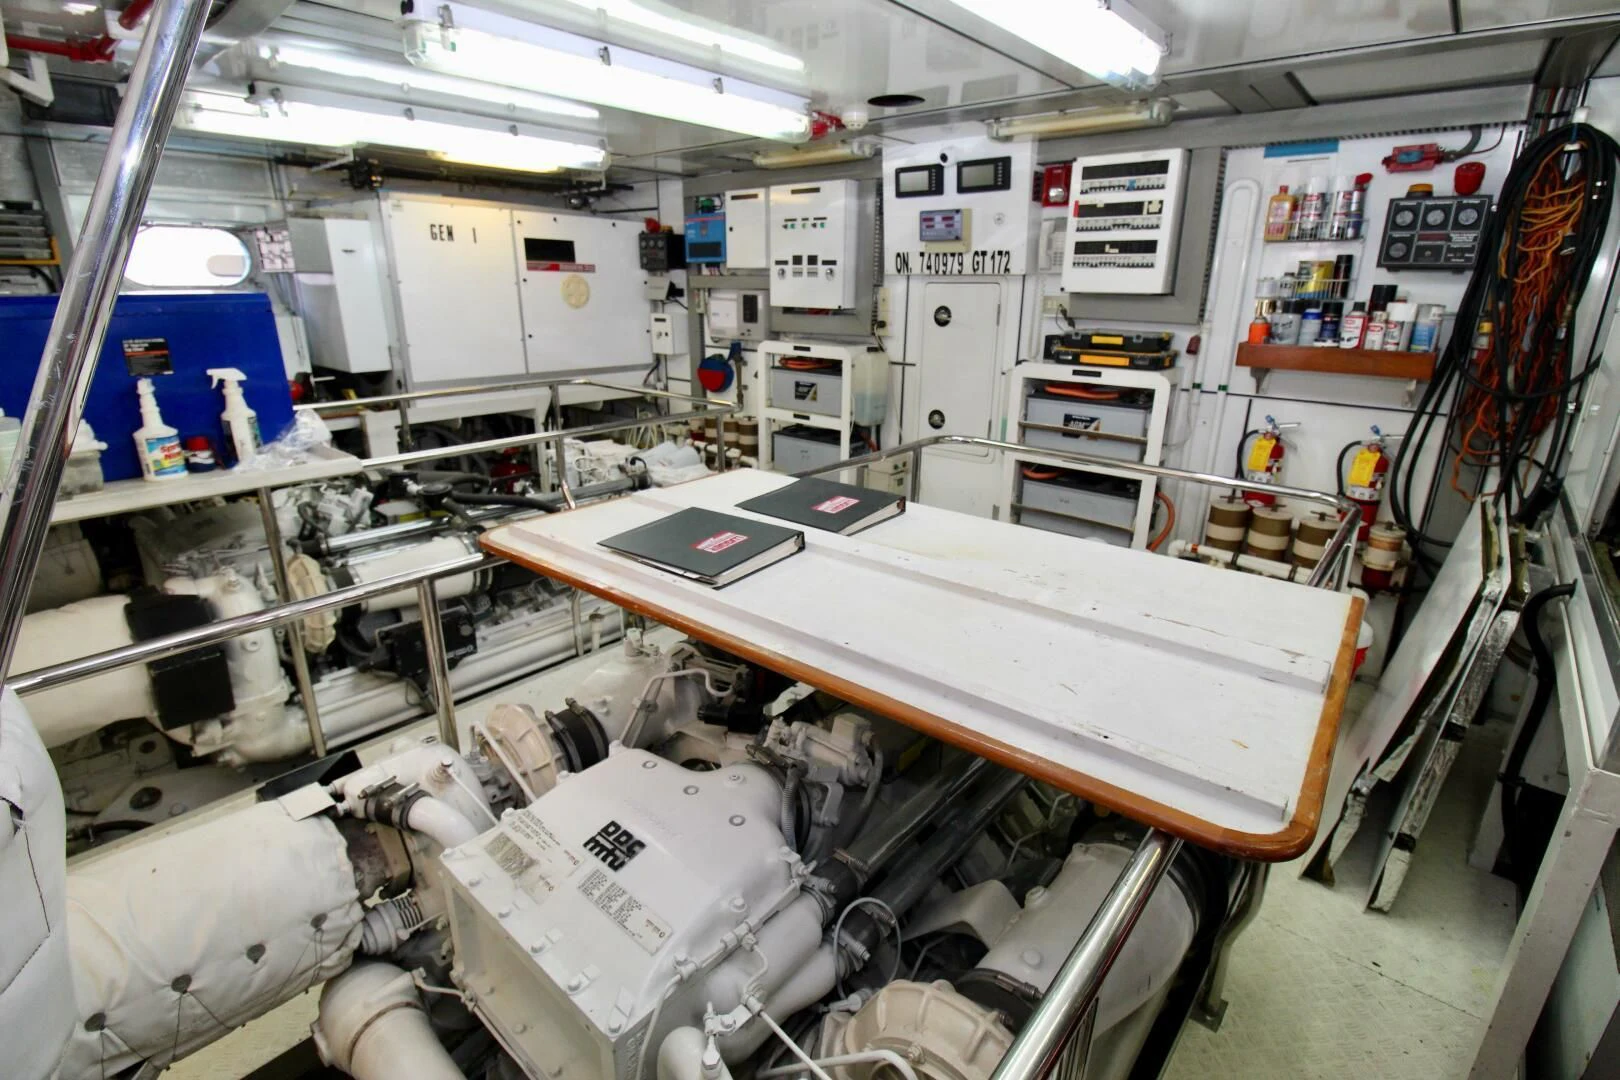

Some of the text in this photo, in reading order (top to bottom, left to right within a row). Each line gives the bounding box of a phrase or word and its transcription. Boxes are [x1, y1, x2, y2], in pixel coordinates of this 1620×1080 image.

[429, 223, 455, 242] GEN
[895, 252, 913, 274] ON.
[919, 251, 964, 275] 740979
[582, 835, 627, 873] mtu
[600, 820, 647, 860] DDC
